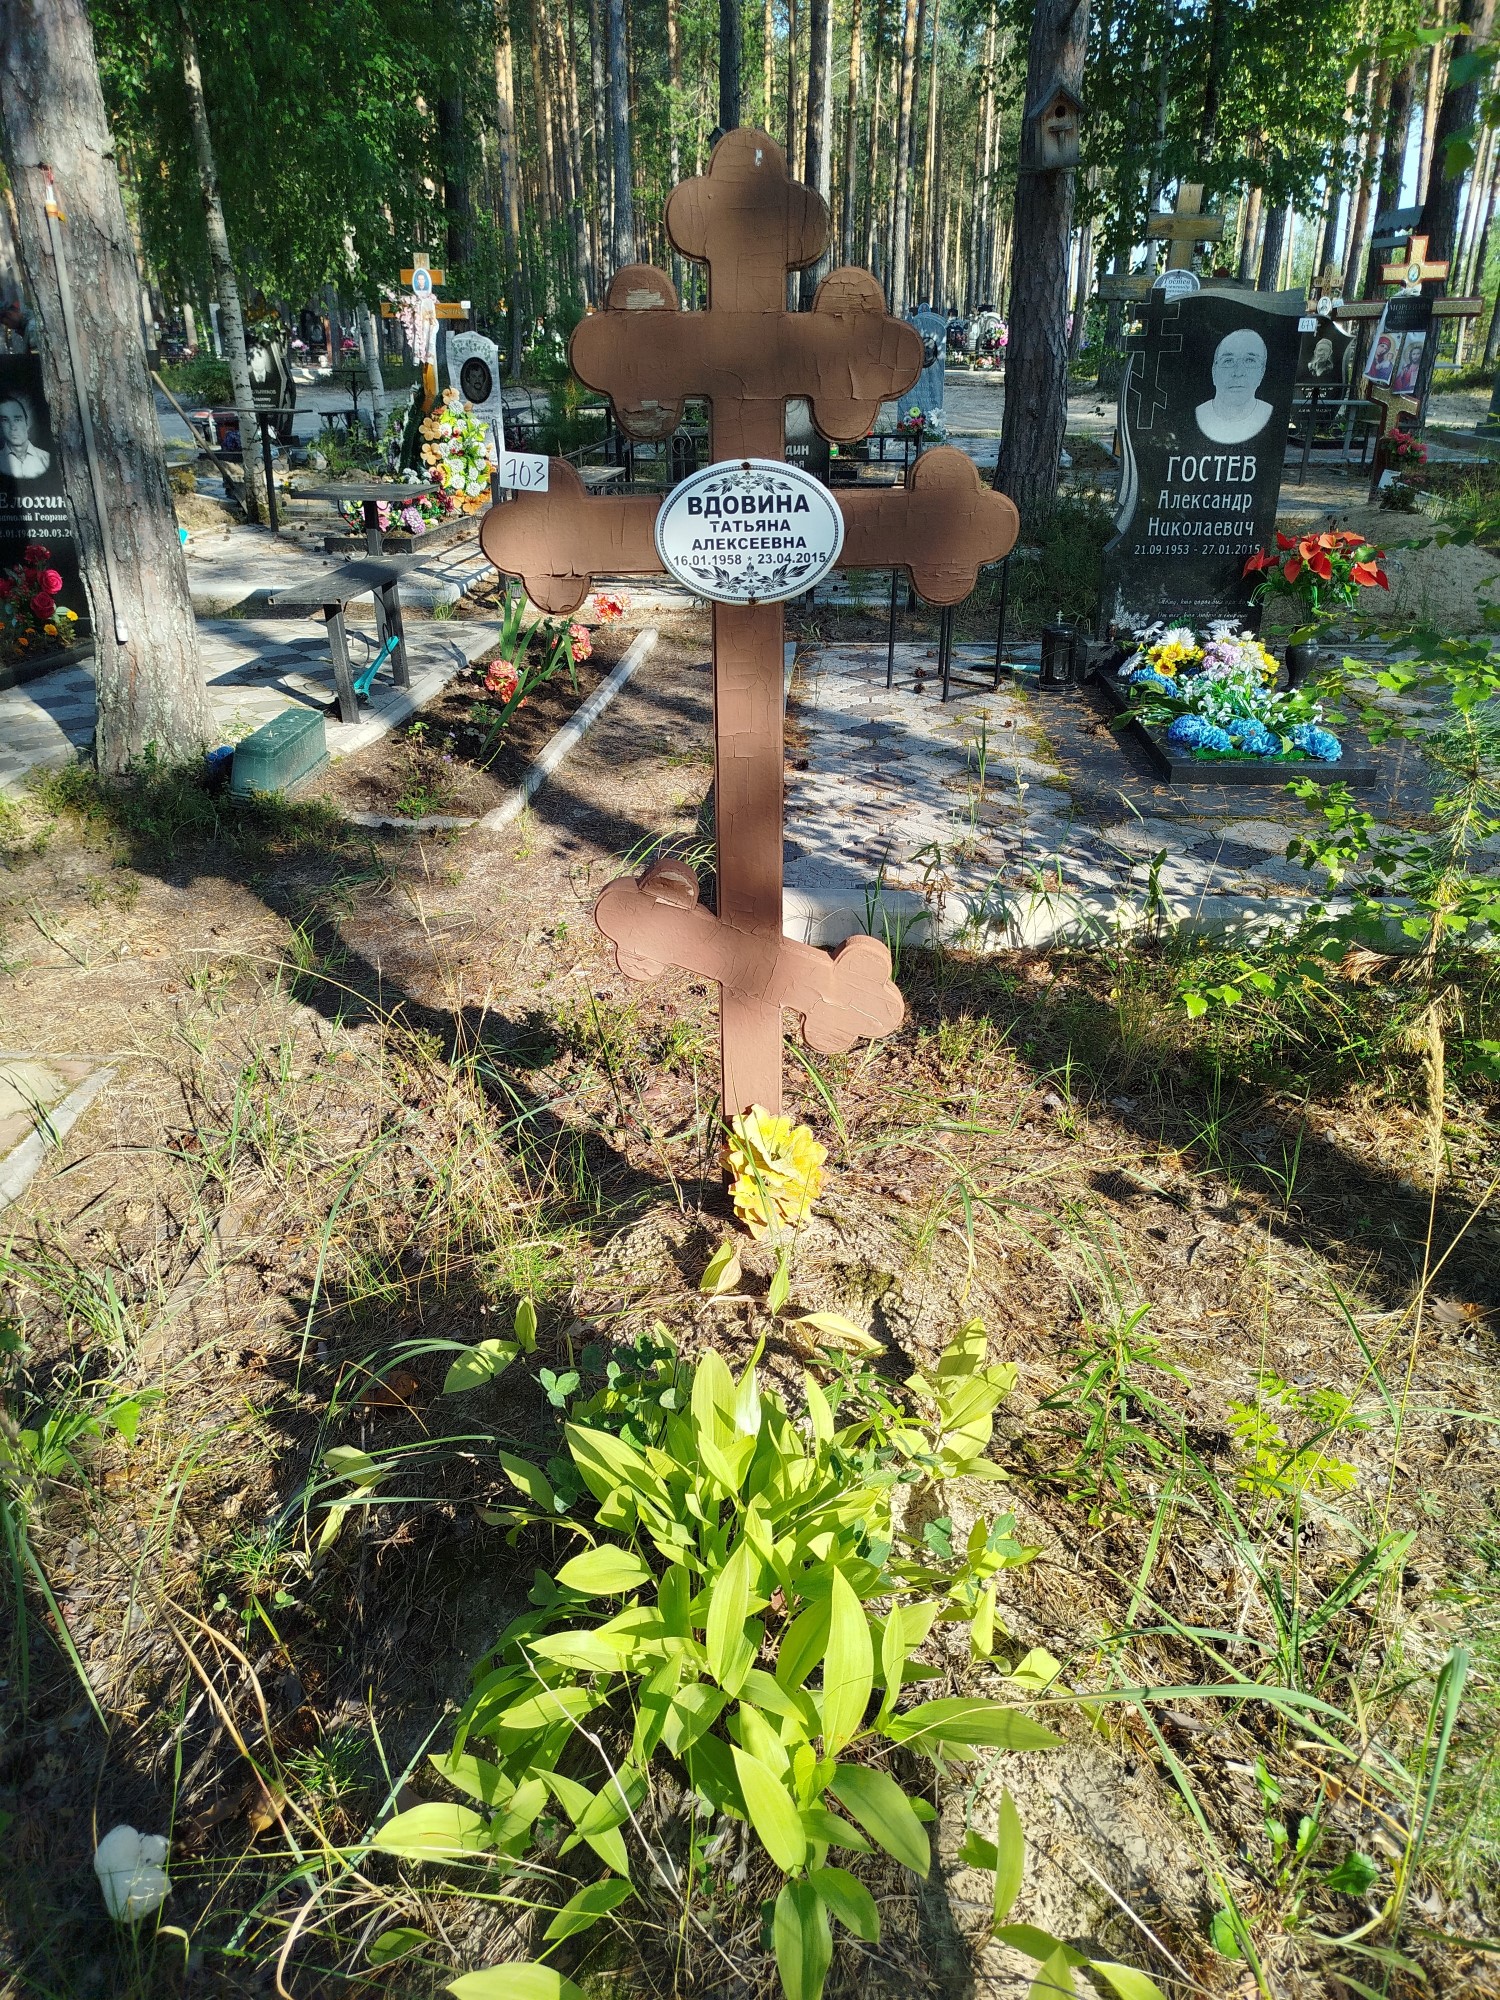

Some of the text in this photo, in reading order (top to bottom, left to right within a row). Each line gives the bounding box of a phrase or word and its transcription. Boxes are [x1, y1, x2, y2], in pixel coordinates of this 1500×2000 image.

[785, 445, 809, 456] ДИН
[505, 458, 545, 487] 703
[1166, 455, 1257, 482] ГОСТЕВ
[687, 494, 810, 519] ВДОВИНА
[1157, 489, 1252, 513] Александр
[34, 512, 68, 522] Георгие
[709, 519, 792, 533] ТАТЬЯНА
[1147, 517, 1254, 537] Николаевич
[691, 536, 807, 551] АЛЕКСЕЕВНА
[1134, 544, 1190, 555] 21.09.1953
[1201, 544, 1261, 555] 27.01.2015
[673, 552, 826, 567] 16.01.1958 23.04.2015
